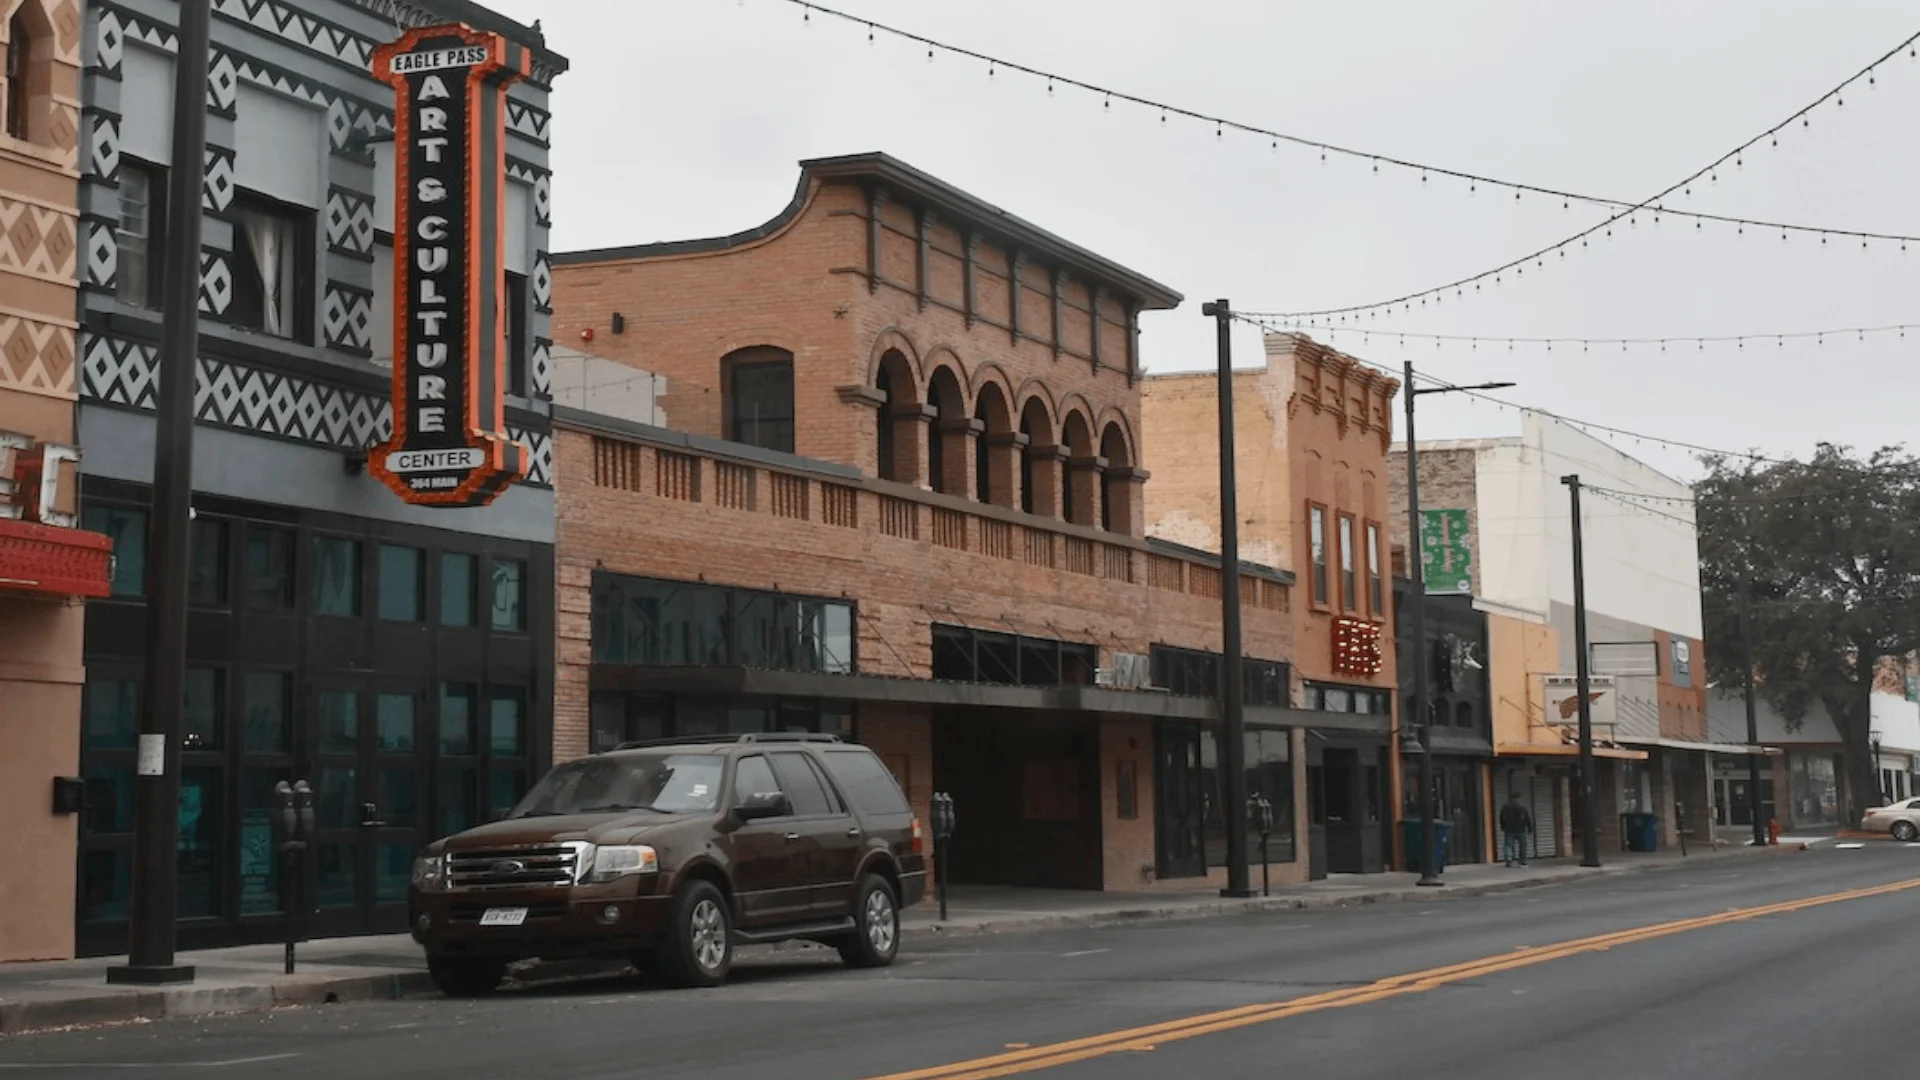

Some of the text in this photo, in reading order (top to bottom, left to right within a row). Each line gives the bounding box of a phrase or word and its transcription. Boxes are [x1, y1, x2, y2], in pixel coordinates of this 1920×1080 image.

[395, 47, 485, 70] EAGLE PASS
[417, 75, 450, 433] ART & CULTURE
[399, 452, 471, 469] CENTER
[431, 475, 458, 488] MAIN
